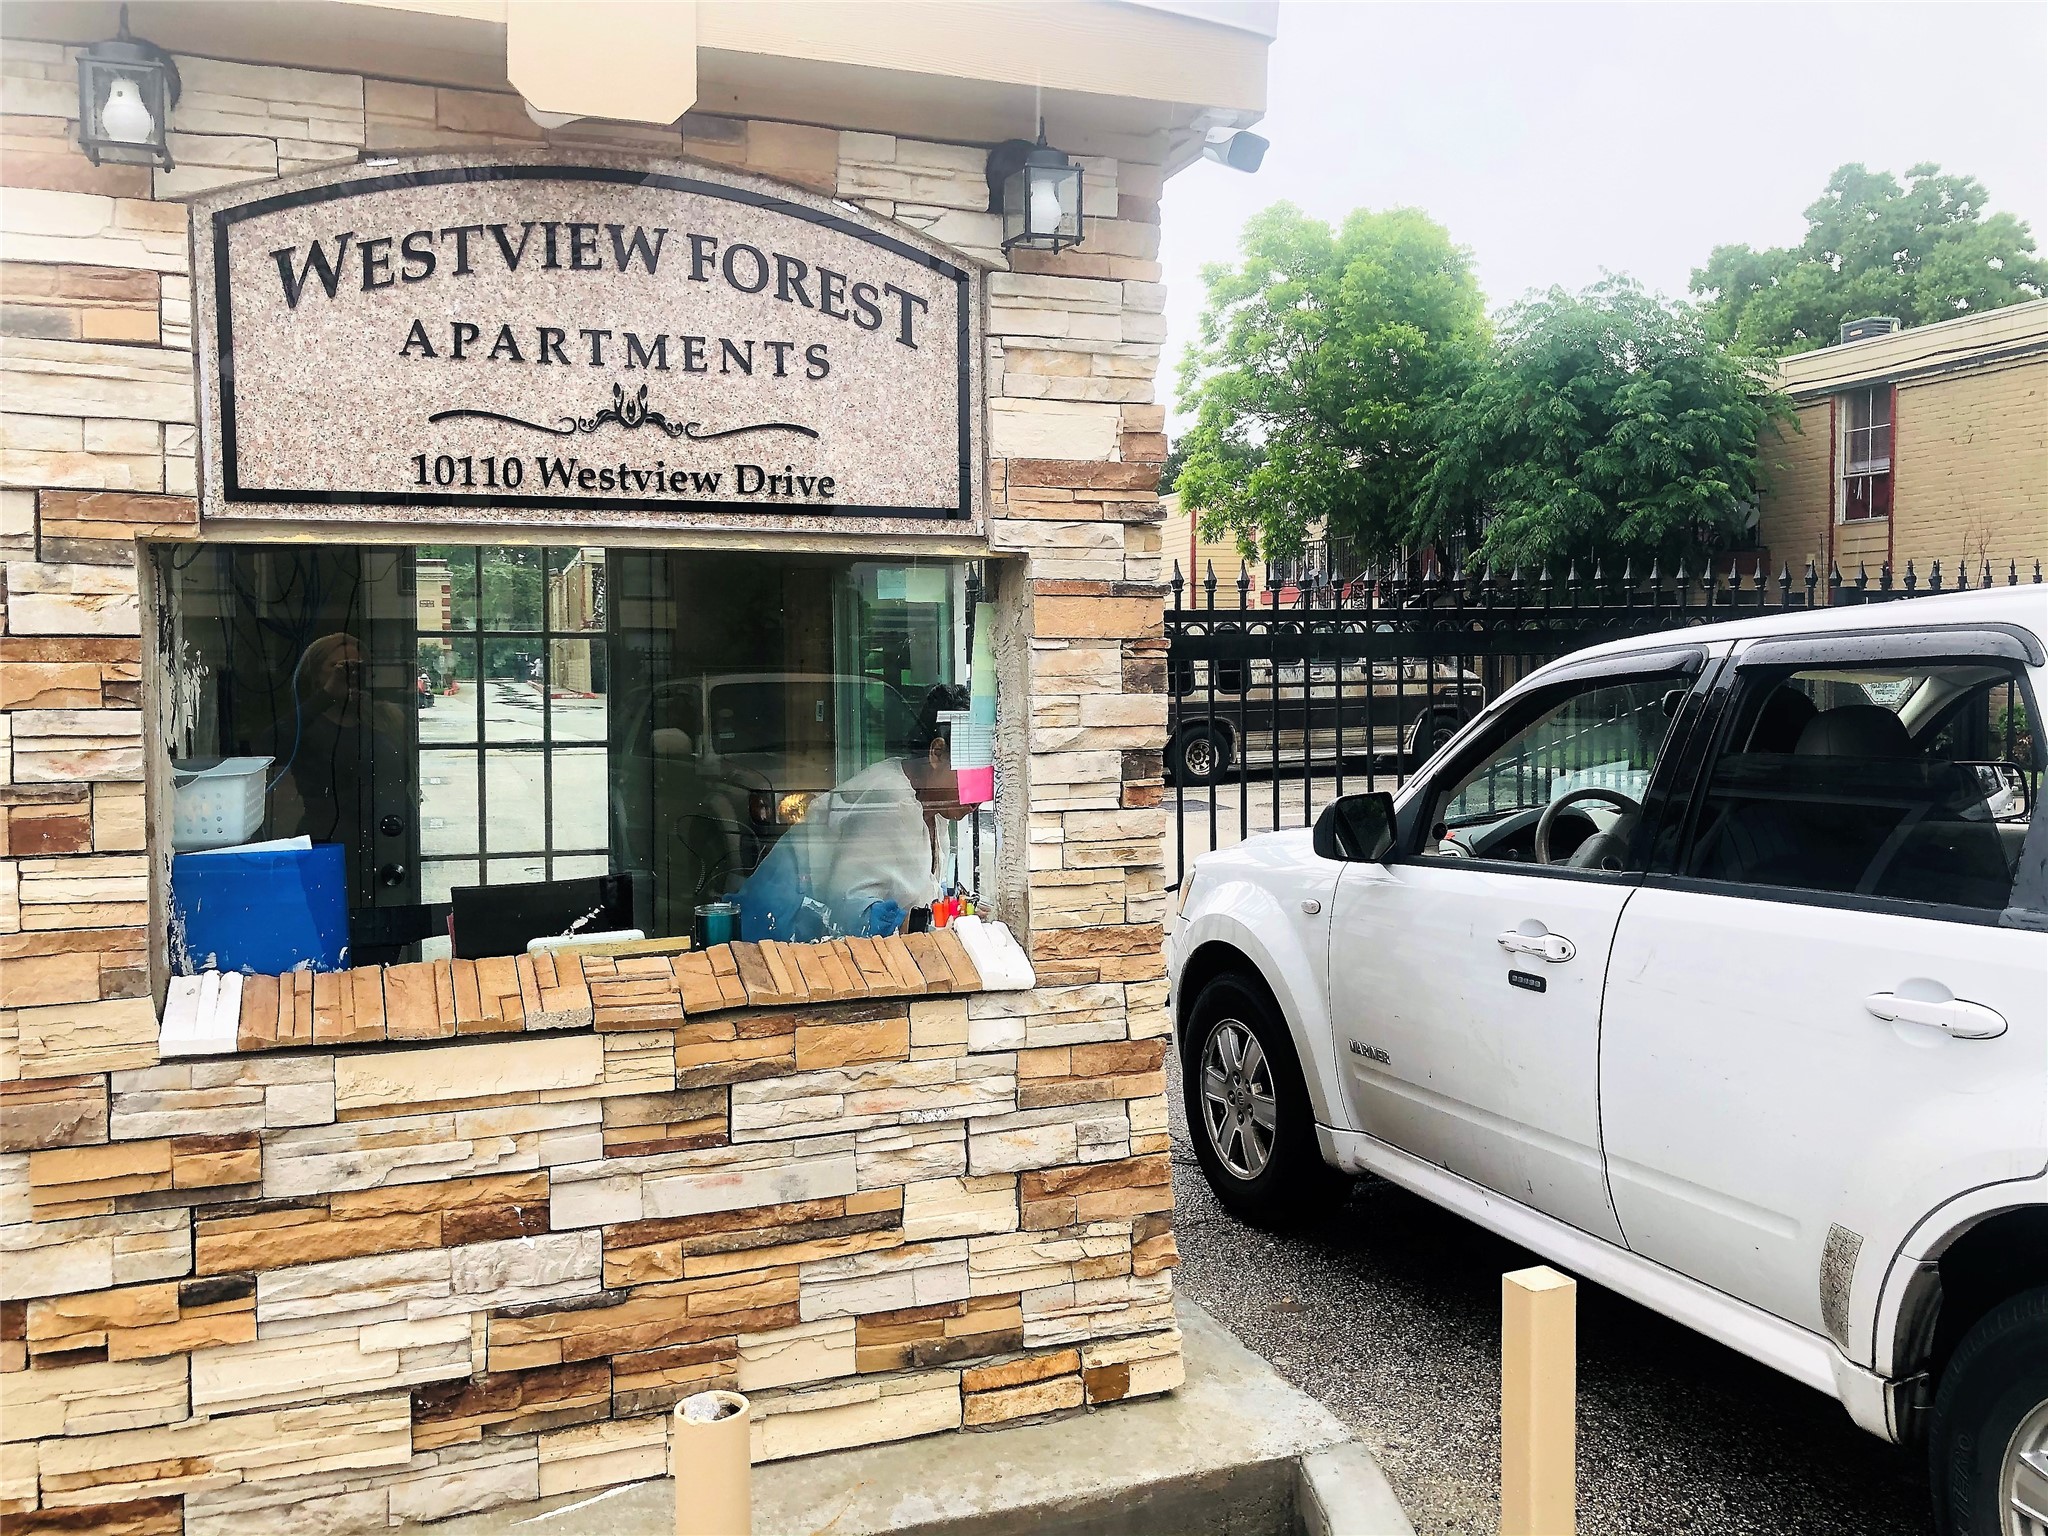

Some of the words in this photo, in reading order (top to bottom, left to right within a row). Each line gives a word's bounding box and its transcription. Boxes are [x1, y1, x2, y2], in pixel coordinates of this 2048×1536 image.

[269, 221, 668, 309] WESTVIEW
[686, 233, 929, 350] FOREST
[398, 318, 831, 380] APARTMENTS
[411, 453, 523, 489] 10110
[535, 456, 723, 495] Westview
[735, 464, 836, 499] Drive
[1349, 1038, 1391, 1065] MARINER
